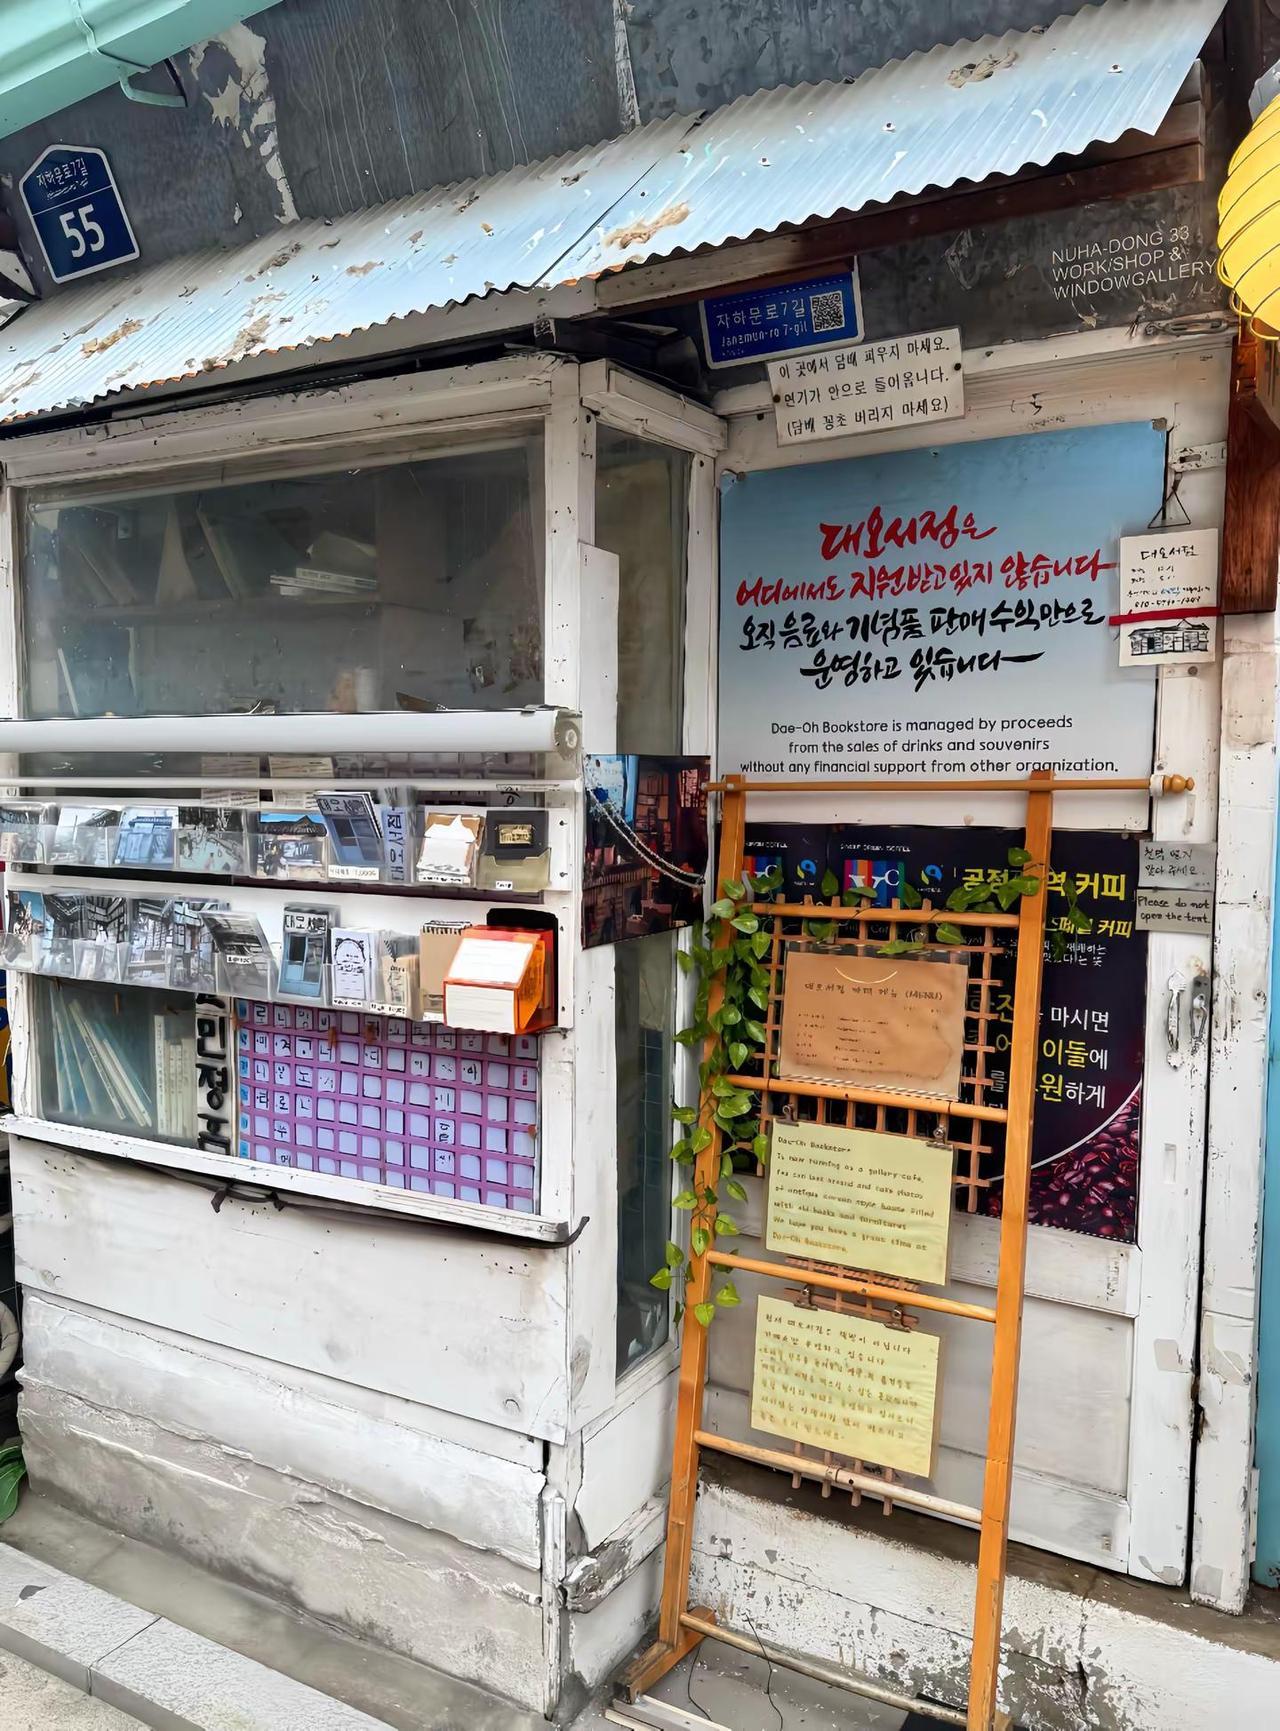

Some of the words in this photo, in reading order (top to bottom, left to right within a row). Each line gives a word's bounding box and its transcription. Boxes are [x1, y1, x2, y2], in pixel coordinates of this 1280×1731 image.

[59, 204, 105, 257] 55
[1052, 231, 1164, 265] NUHA-DONG
[1169, 226, 1190, 243] 33
[1169, 247, 1183, 261] &
[1053, 259, 1218, 300] WINDOWGALLERY
[716, 298, 806, 328] 자하문로7길
[779, 364, 791, 379] 이
[835, 351, 858, 371] 담배
[864, 342, 900, 365] 피우지
[907, 336, 950, 355] 마세요.
[784, 388, 822, 408] 연기가
[828, 380, 867, 400] 안으로
[874, 365, 949, 394] 들어옵니다.
[854, 404, 894, 424] 버리지
[902, 397, 949, 416] 마세요)
[771, 722, 819, 735] Dae-Oh
[822, 720, 888, 733] Bookstore
[892, 720, 902, 732] is
[905, 717, 974, 734] managed
[979, 717, 996, 732] by
[1001, 715, 1073, 732] proceeds
[788, 741, 819, 753] from
[822, 741, 844, 753] the
[847, 739, 880, 752] sales
[883, 739, 898, 752] of
[901, 738, 943, 752] drinks
[947, 738, 975, 751] and
[979, 737, 1050, 751] souvenirs
[740, 760, 785, 773] without
[788, 762, 811, 775] any
[814, 760, 870, 773] financial
[873, 760, 927, 775] support
[931, 759, 966, 773] from
[970, 759, 1011, 773] other
[1016, 758, 1119, 773] organization.
[1075, 872, 1126, 900] 커피
[1138, 895, 1170, 908] Please
[1175, 897, 1187, 907] do
[1190, 899, 1210, 909] not
[1097, 919, 1133, 938] 커피
[1140, 912, 1163, 924] open
[1165, 912, 1183, 921] the
[1051, 1006, 1109, 1033] 마시면
